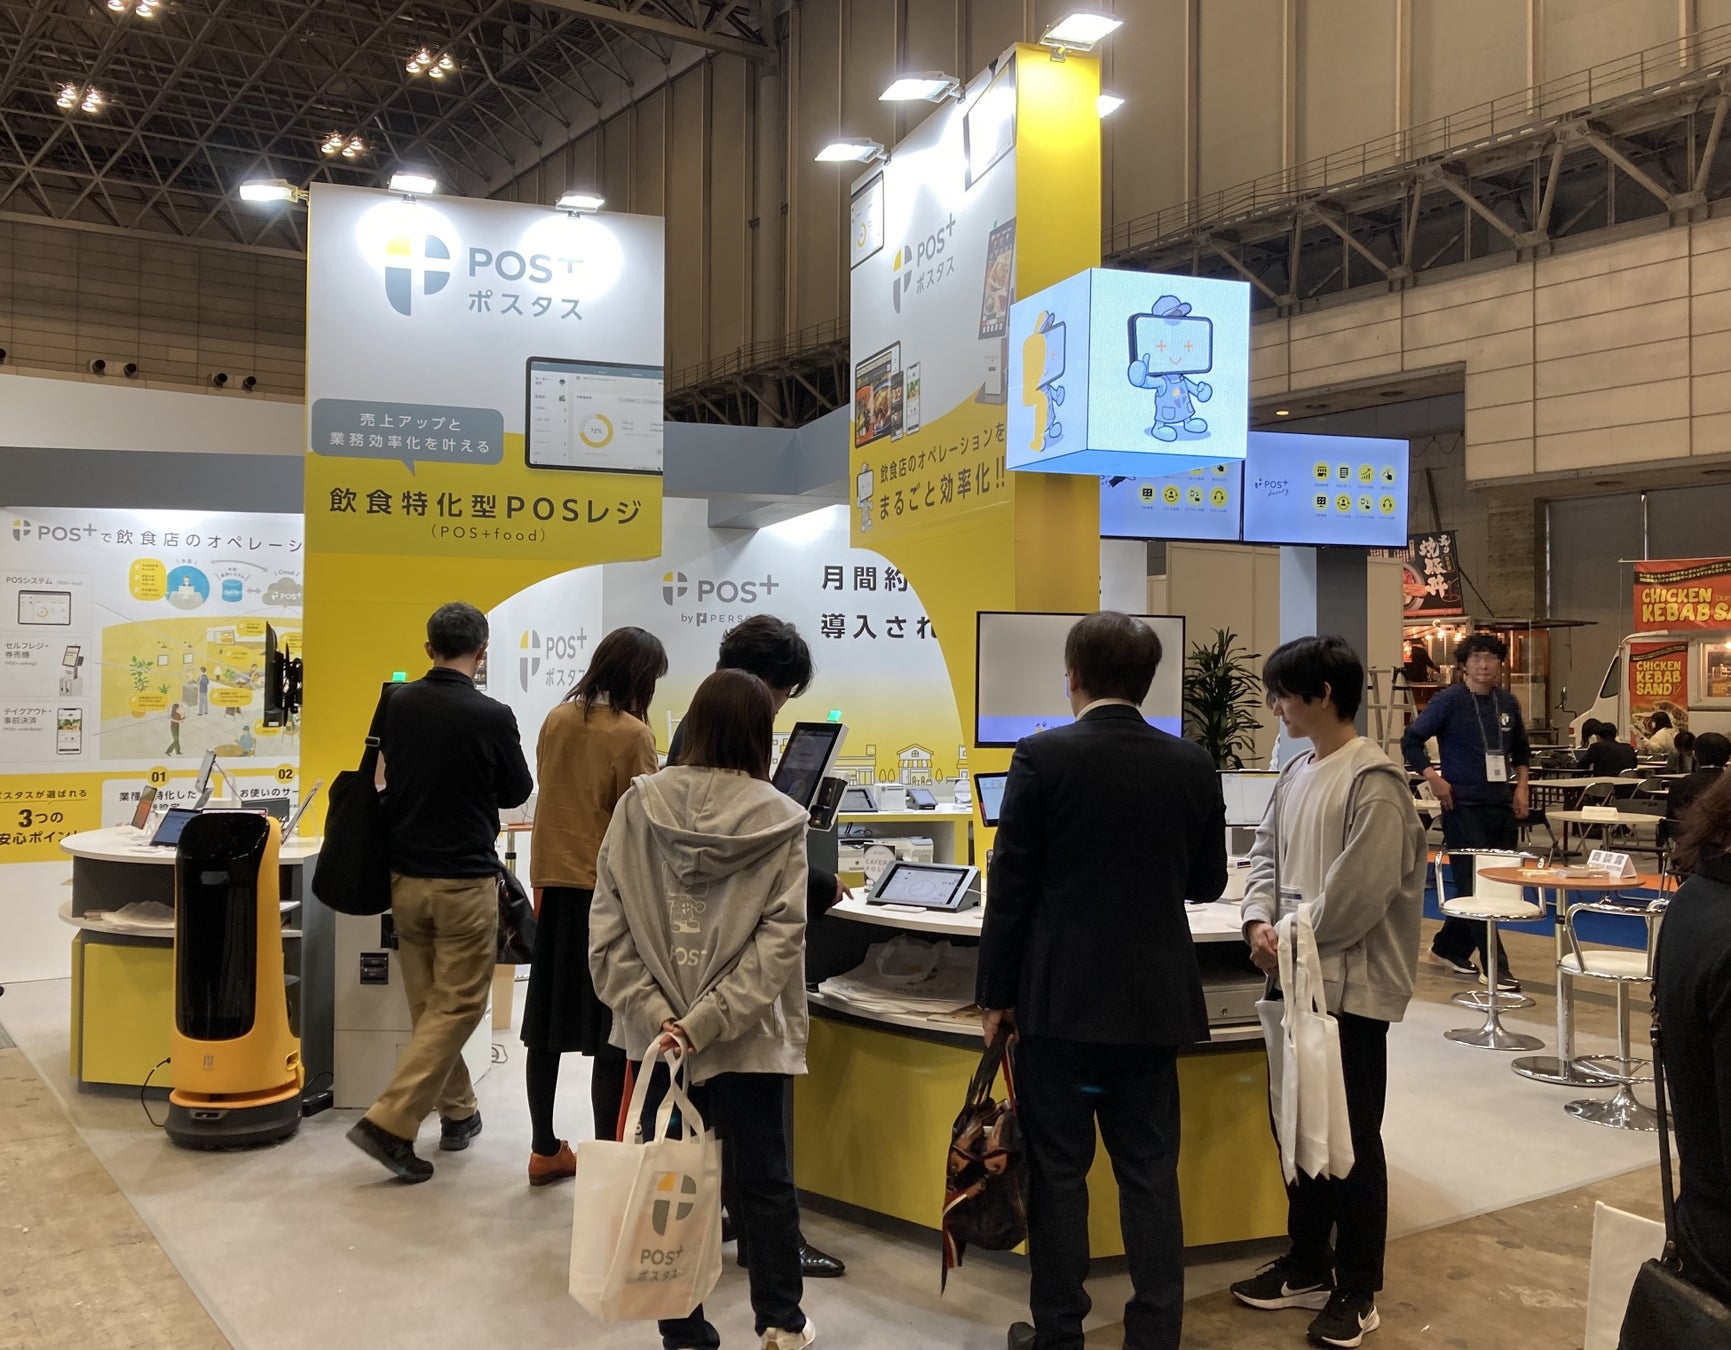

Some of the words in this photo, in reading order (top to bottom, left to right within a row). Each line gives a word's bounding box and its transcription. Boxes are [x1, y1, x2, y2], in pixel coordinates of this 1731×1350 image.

[917, 213, 956, 268] POS+
[917, 255, 956, 295] ポスタス
[468, 289, 583, 320] ポスタス
[360, 412, 462, 432] 売上アップと
[330, 431, 490, 454] 業務効率化を叶える
[880, 423, 1006, 485] 飲食店のオペレーションを
[1264, 479, 1289, 490] POS+
[329, 487, 642, 525] 飲食特化型POSレジ
[431, 524, 545, 544] (POS+food)
[5, 576, 54, 586] POSシステム
[821, 565, 909, 592] 月間約
[698, 574, 780, 604] POS+
[1641, 587, 1713, 604] CHICKEN
[681, 613, 693, 624] by
[1641, 602, 1712, 623] KEBAB
[820, 613, 938, 640] 導入され
[546, 626, 588, 660] POS+
[1636, 660, 1681, 671] CHICKEN
[1636, 670, 1682, 683] KEBAB
[1635, 682, 1673, 696] SAND
[152, 771, 166, 783] 01
[278, 768, 293, 780] 02
[119, 790, 197, 802] 業種特化した
[18, 808, 64, 828] 3つの
[0, 830, 78, 846] 安心ポイン
[640, 1245, 684, 1266] POS+
